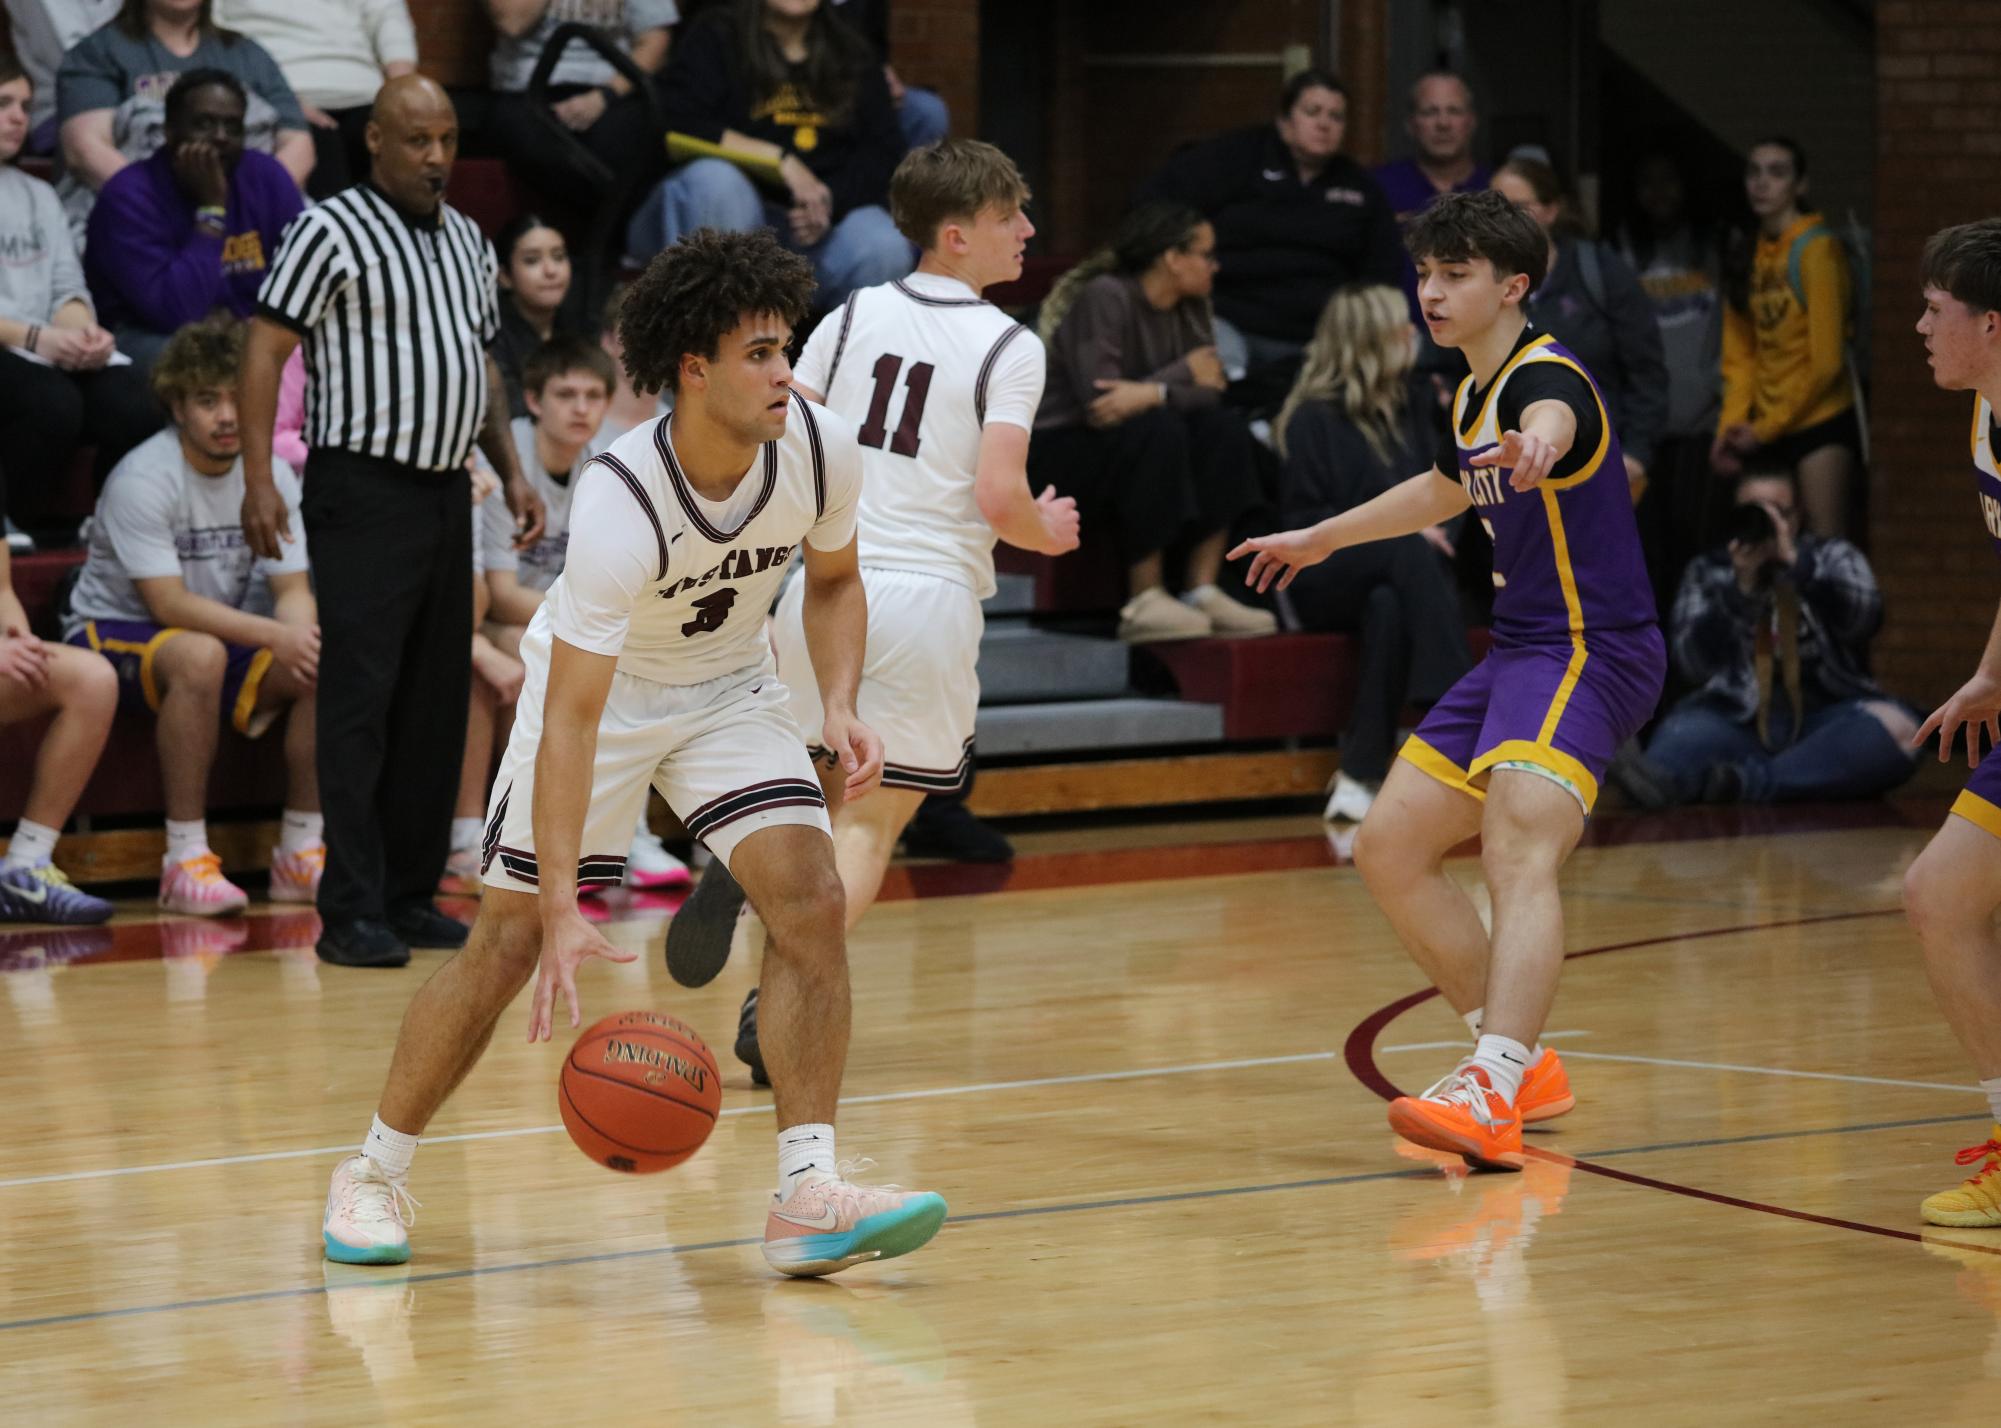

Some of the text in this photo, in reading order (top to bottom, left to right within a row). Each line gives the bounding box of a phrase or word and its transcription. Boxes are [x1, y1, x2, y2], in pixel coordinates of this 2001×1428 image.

[857, 353, 935, 459] 11
[1473, 466, 1505, 506] CITY
[603, 1039, 708, 1093] SPALDING
